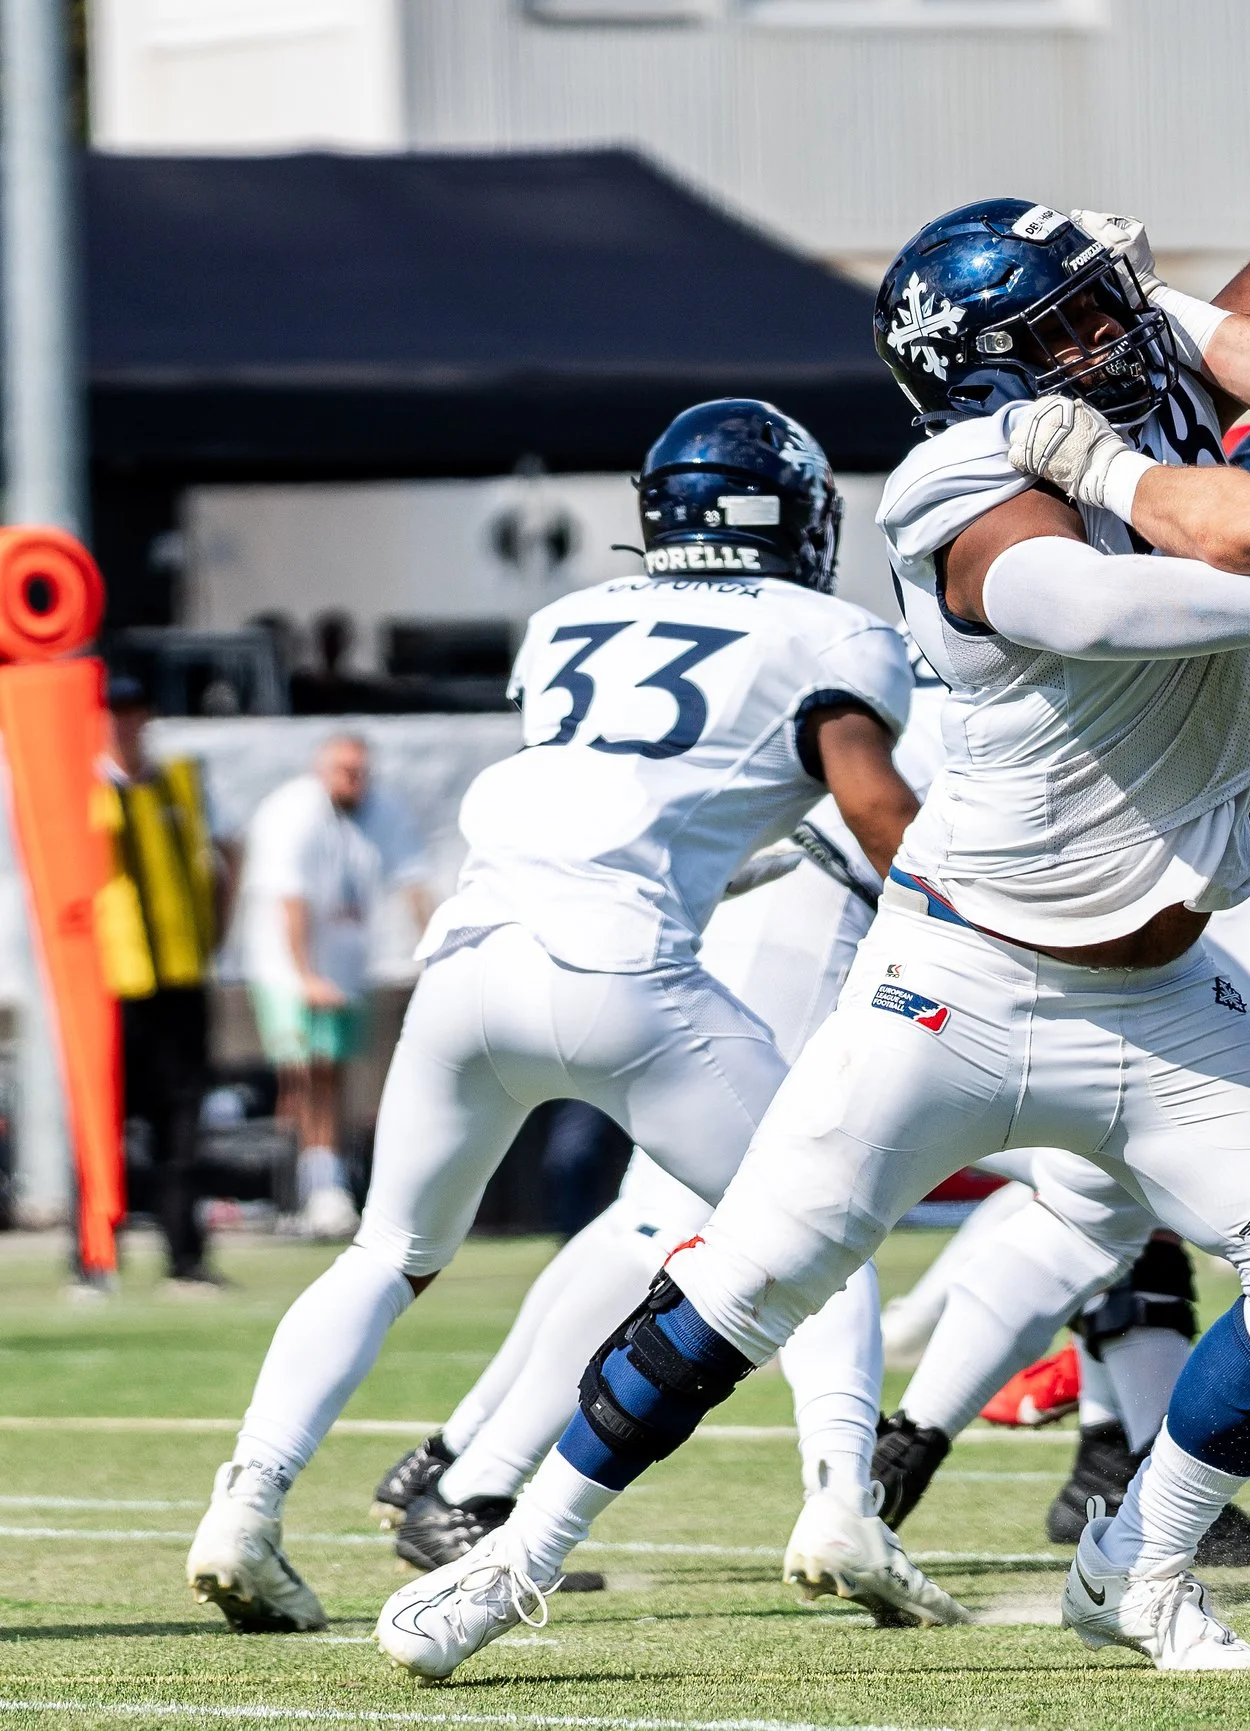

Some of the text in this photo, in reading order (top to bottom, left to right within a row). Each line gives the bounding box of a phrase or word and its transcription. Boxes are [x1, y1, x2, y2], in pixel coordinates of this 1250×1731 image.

[644, 546, 760, 573] FORELLE
[541, 620, 749, 759] 33
[876, 992, 900, 1003] LEAGUE
[880, 986, 913, 1001] EUROPEAN
[873, 999, 904, 1011] FOOTBALL
